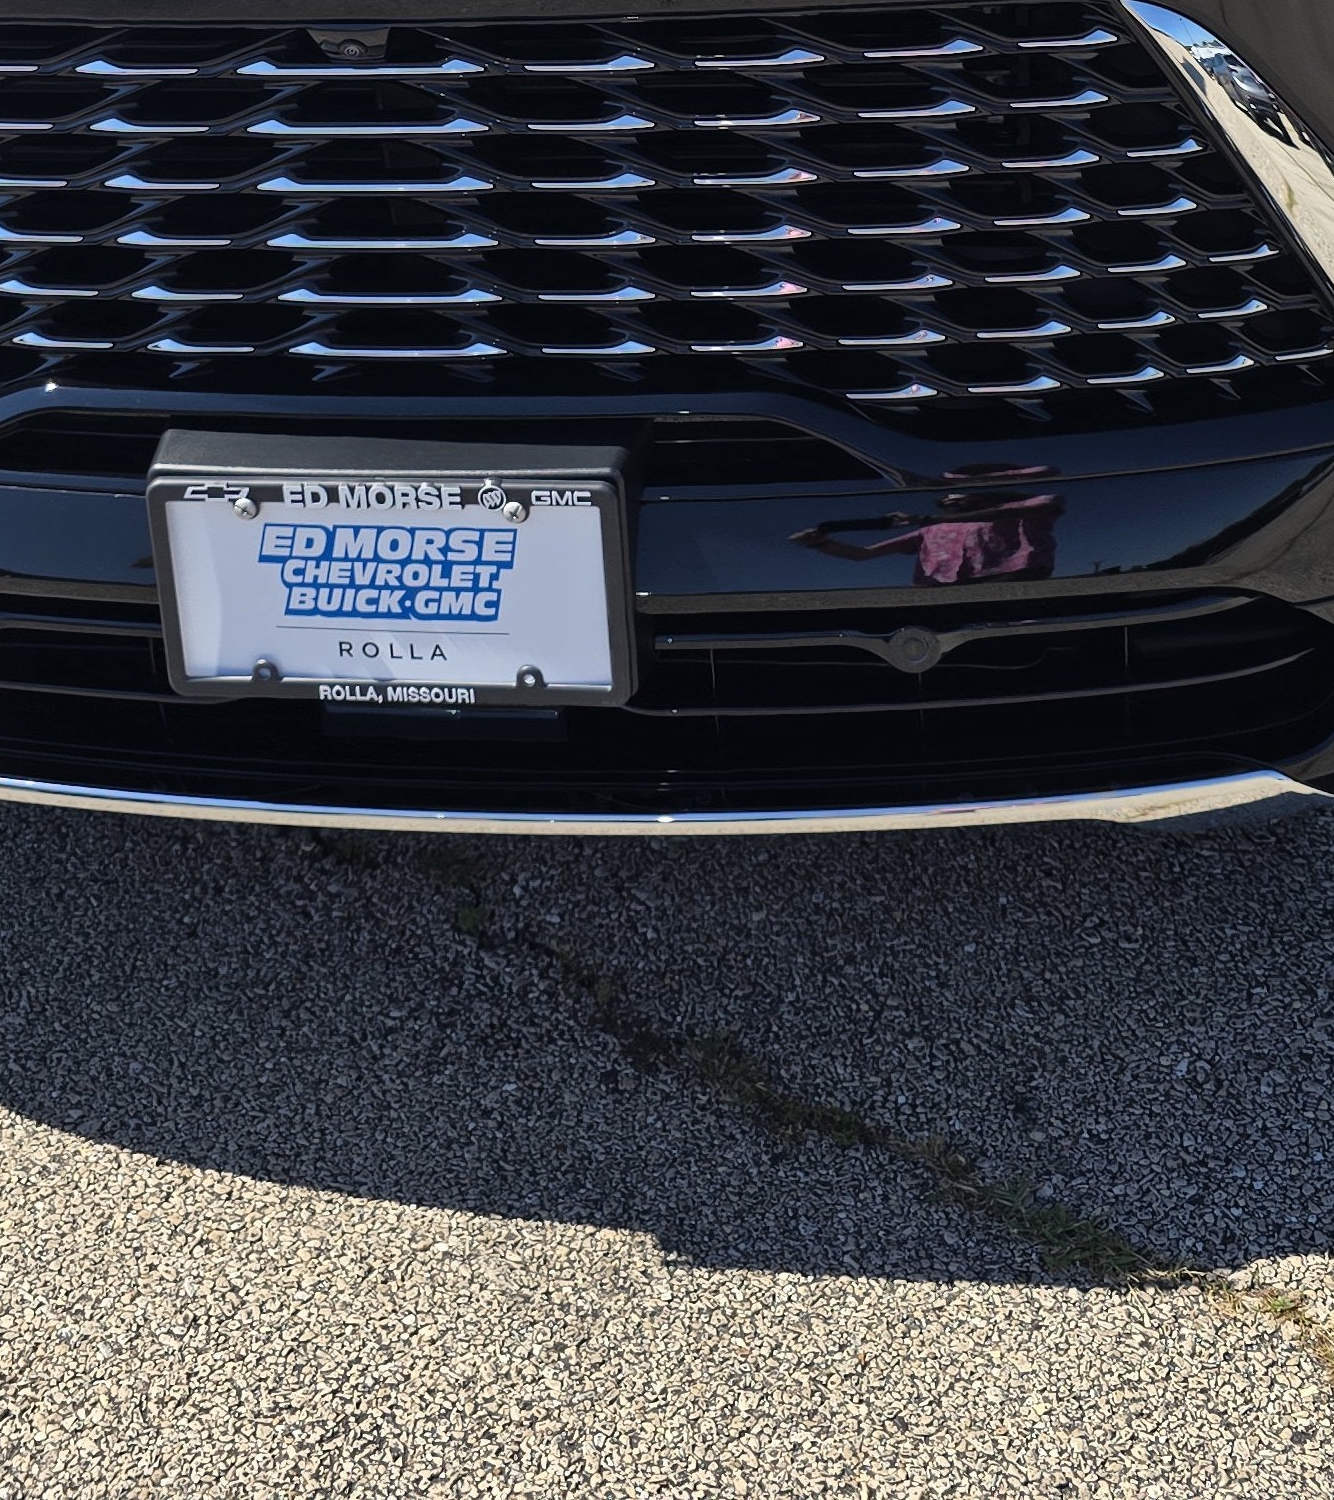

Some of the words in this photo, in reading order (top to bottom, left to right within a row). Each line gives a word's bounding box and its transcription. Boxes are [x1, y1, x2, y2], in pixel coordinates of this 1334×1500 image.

[282, 482, 328, 509] ED
[338, 483, 462, 511] MORSE
[531, 489, 591, 507] GMC
[261, 525, 327, 558] ED
[332, 527, 515, 562] MORSE
[283, 558, 497, 589] CHEVROLET
[338, 640, 448, 661] ROLLA
[386, 686, 476, 705] MISSOURI
